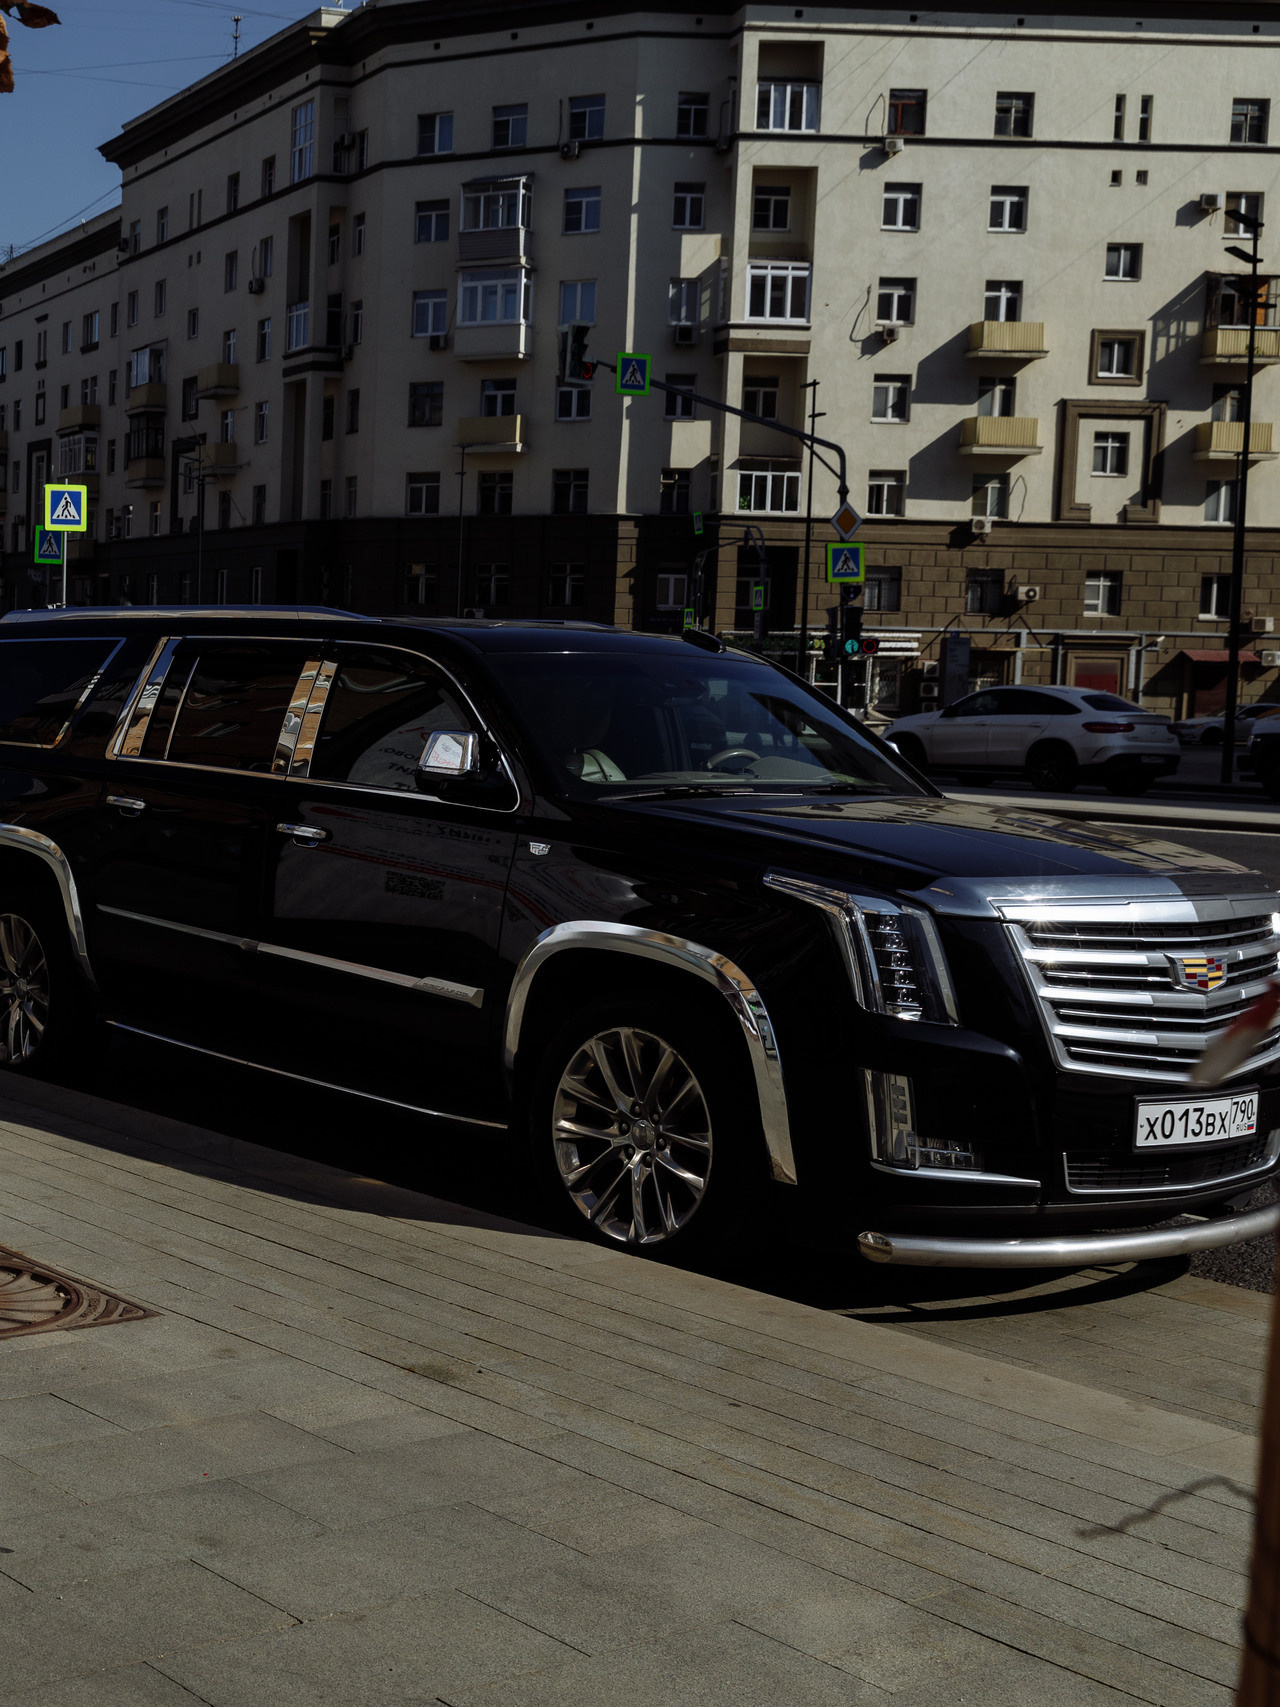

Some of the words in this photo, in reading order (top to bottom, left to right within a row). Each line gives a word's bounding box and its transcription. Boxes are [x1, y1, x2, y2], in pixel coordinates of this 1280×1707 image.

[1144, 1107, 1229, 1140] Х013ВХ
[1232, 1098, 1254, 1124] 790
[1235, 1122, 1248, 1132] RUS
